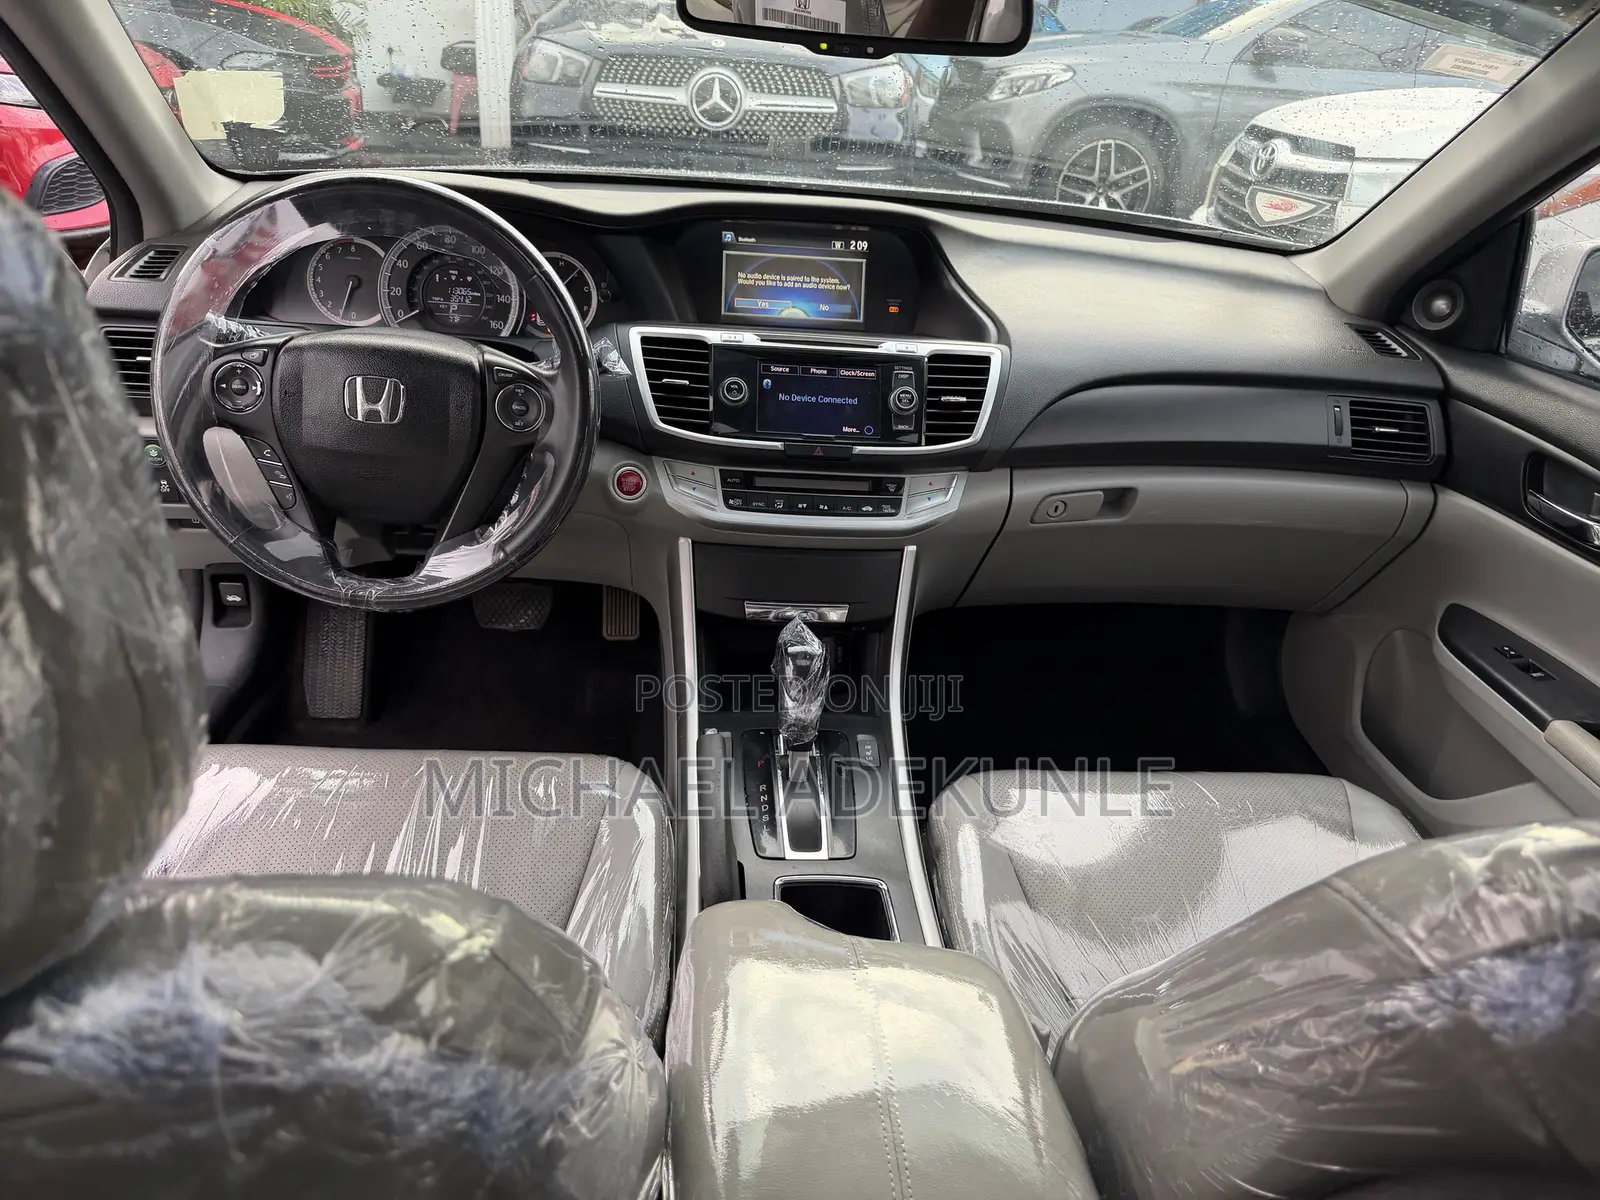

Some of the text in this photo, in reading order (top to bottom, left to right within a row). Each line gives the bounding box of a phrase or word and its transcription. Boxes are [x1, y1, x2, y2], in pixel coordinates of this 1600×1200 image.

[444, 234, 456, 244] 80
[350, 244, 356, 253] 8
[417, 241, 429, 250] 60
[471, 245, 486, 254] 100
[337, 246, 343, 254] 7
[325, 252, 331, 260] 6
[318, 263, 323, 271] 5
[396, 260, 409, 269] 40
[489, 265, 504, 276] 120
[390, 287, 402, 296] 20
[496, 294, 510, 304] 140
[327, 300, 333, 308] 2
[757, 300, 769, 308] Yes
[351, 311, 356, 319] 0
[397, 310, 404, 318] 0
[490, 320, 504, 330] 160
[770, 365, 790, 373] Source
[810, 367, 827, 375] Phone
[840, 369, 875, 377] Clock/Screen
[778, 393, 858, 404] No Device Connected
[757, 760, 764, 768] P
[760, 784, 767, 792] R
[761, 794, 768, 802] N
[762, 804, 769, 812] D
[762, 814, 769, 822] S
